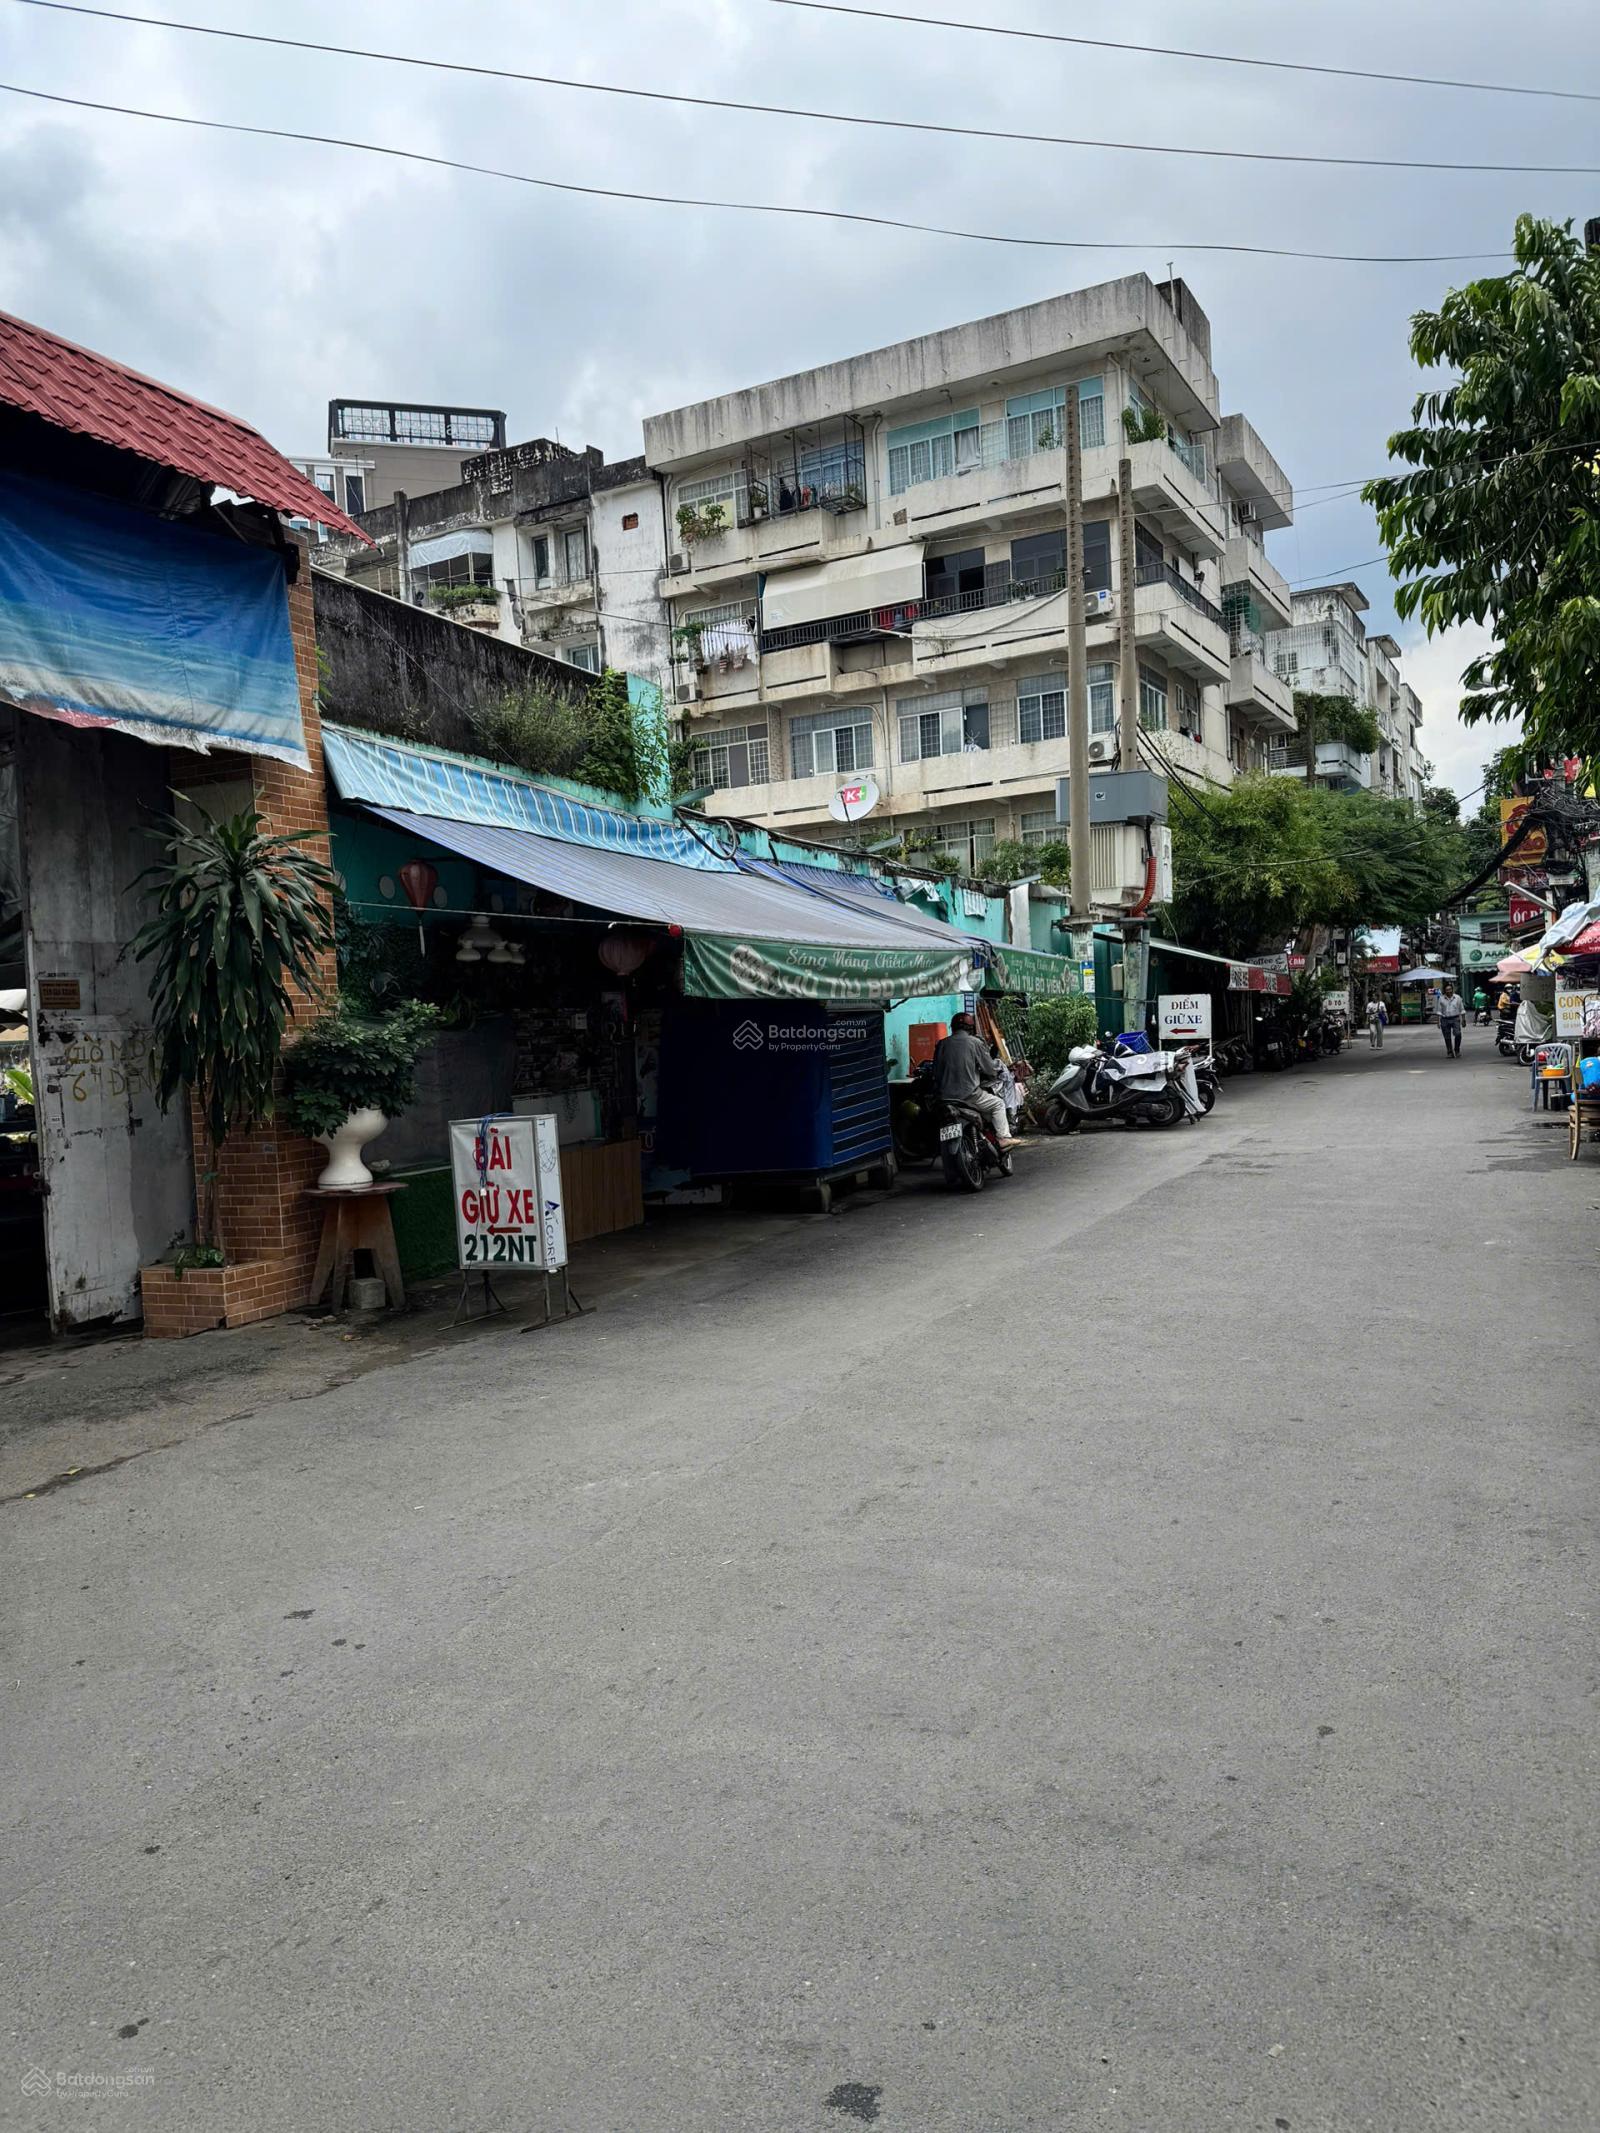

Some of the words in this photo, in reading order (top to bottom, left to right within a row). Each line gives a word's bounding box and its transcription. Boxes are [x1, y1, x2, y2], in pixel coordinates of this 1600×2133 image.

[1187, 1015, 1203, 1024] XE
[461, 1180, 500, 1224] GIỮ
[506, 1189, 535, 1224] XE
[464, 1233, 537, 1263] 212NT
